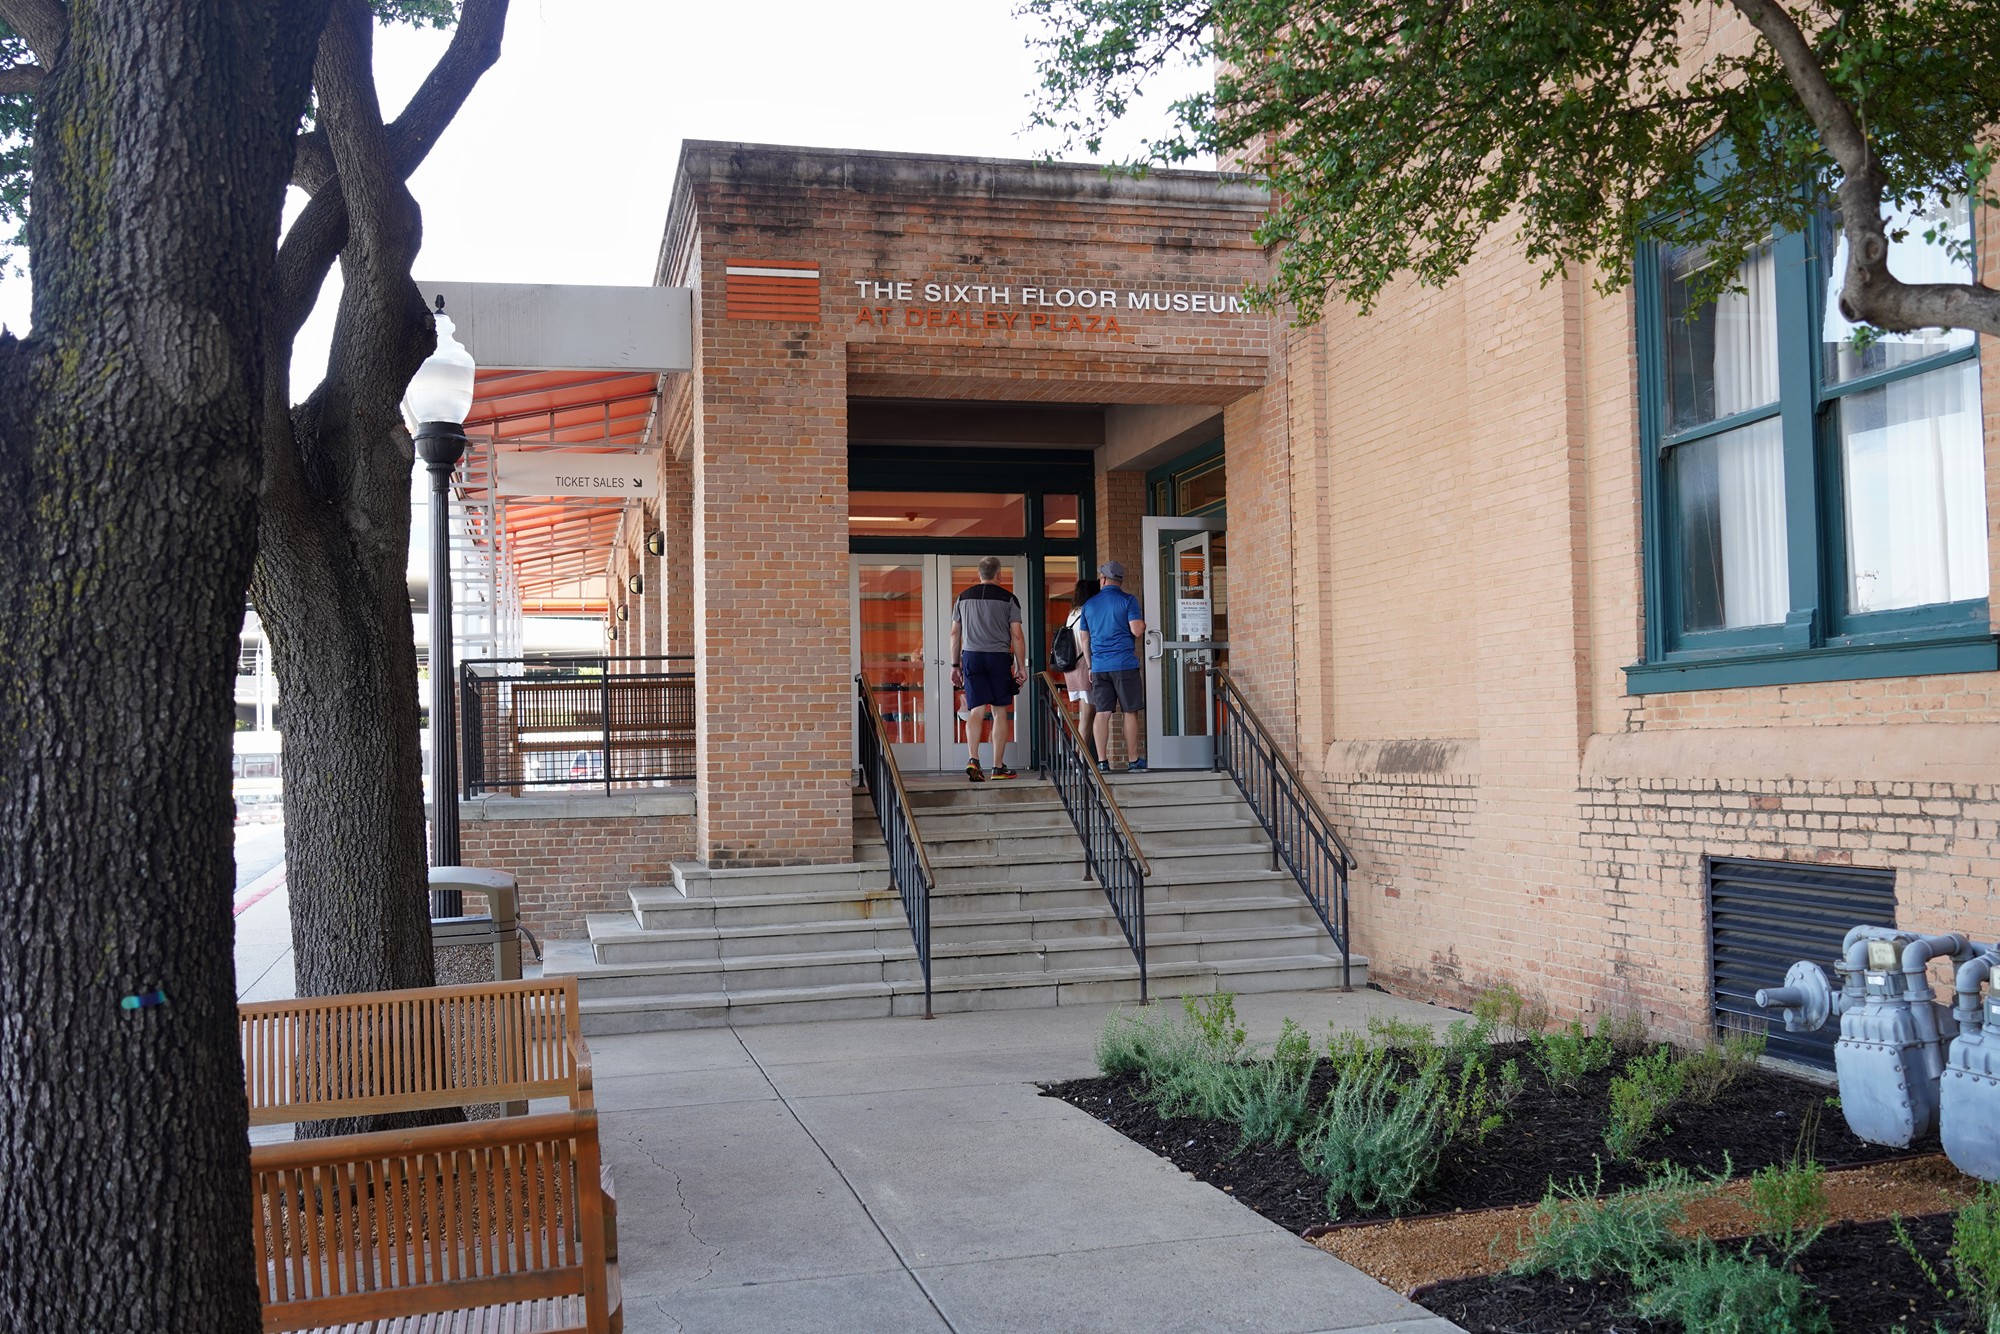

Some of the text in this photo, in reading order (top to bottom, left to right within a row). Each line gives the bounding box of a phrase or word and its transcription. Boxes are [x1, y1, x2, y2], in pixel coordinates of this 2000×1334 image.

[855, 281, 1250, 314] THE SIXTH FLOOR MUSEUM
[855, 306, 1121, 333] AT DEALEY PLAZA
[555, 476, 624, 488] TICKET SALES
